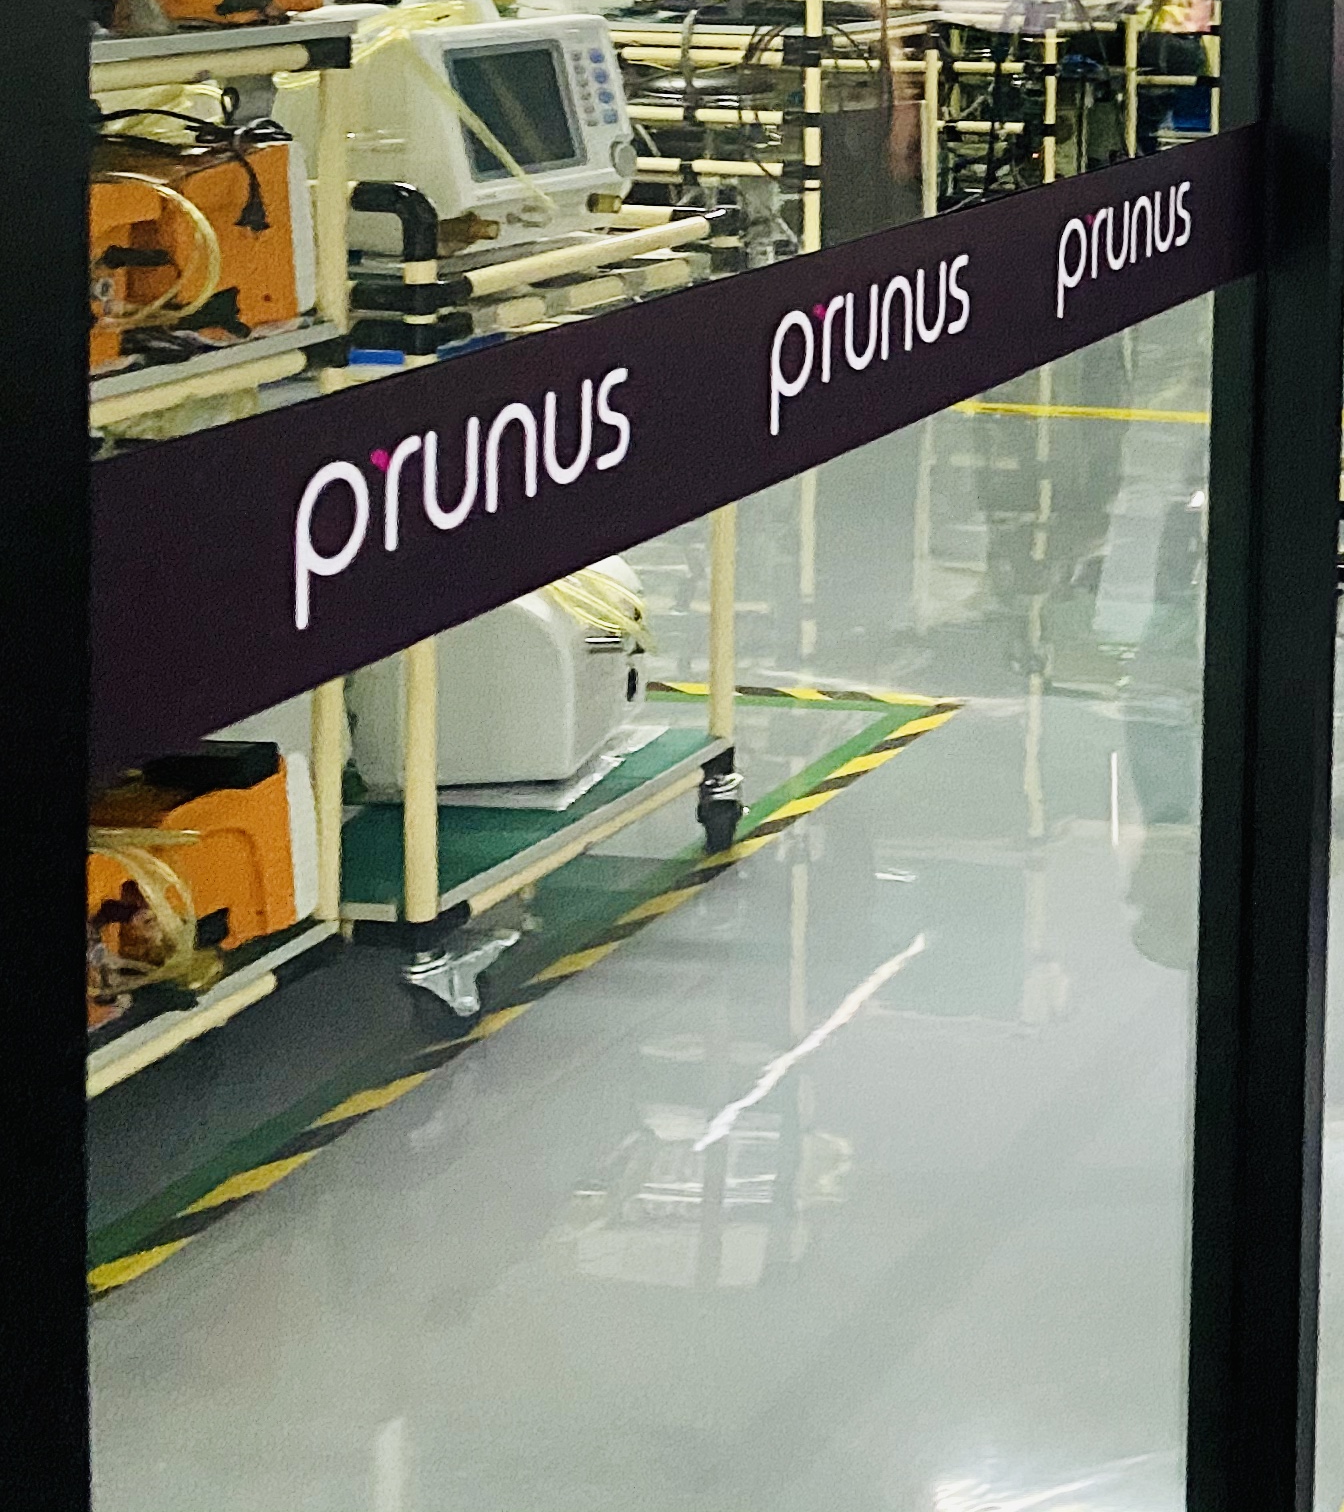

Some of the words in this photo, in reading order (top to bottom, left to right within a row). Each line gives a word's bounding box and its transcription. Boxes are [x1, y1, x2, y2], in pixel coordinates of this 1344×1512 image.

[294, 366, 632, 630] prunus
[769, 253, 970, 436] prunus
[1056, 180, 1191, 319] prunus
